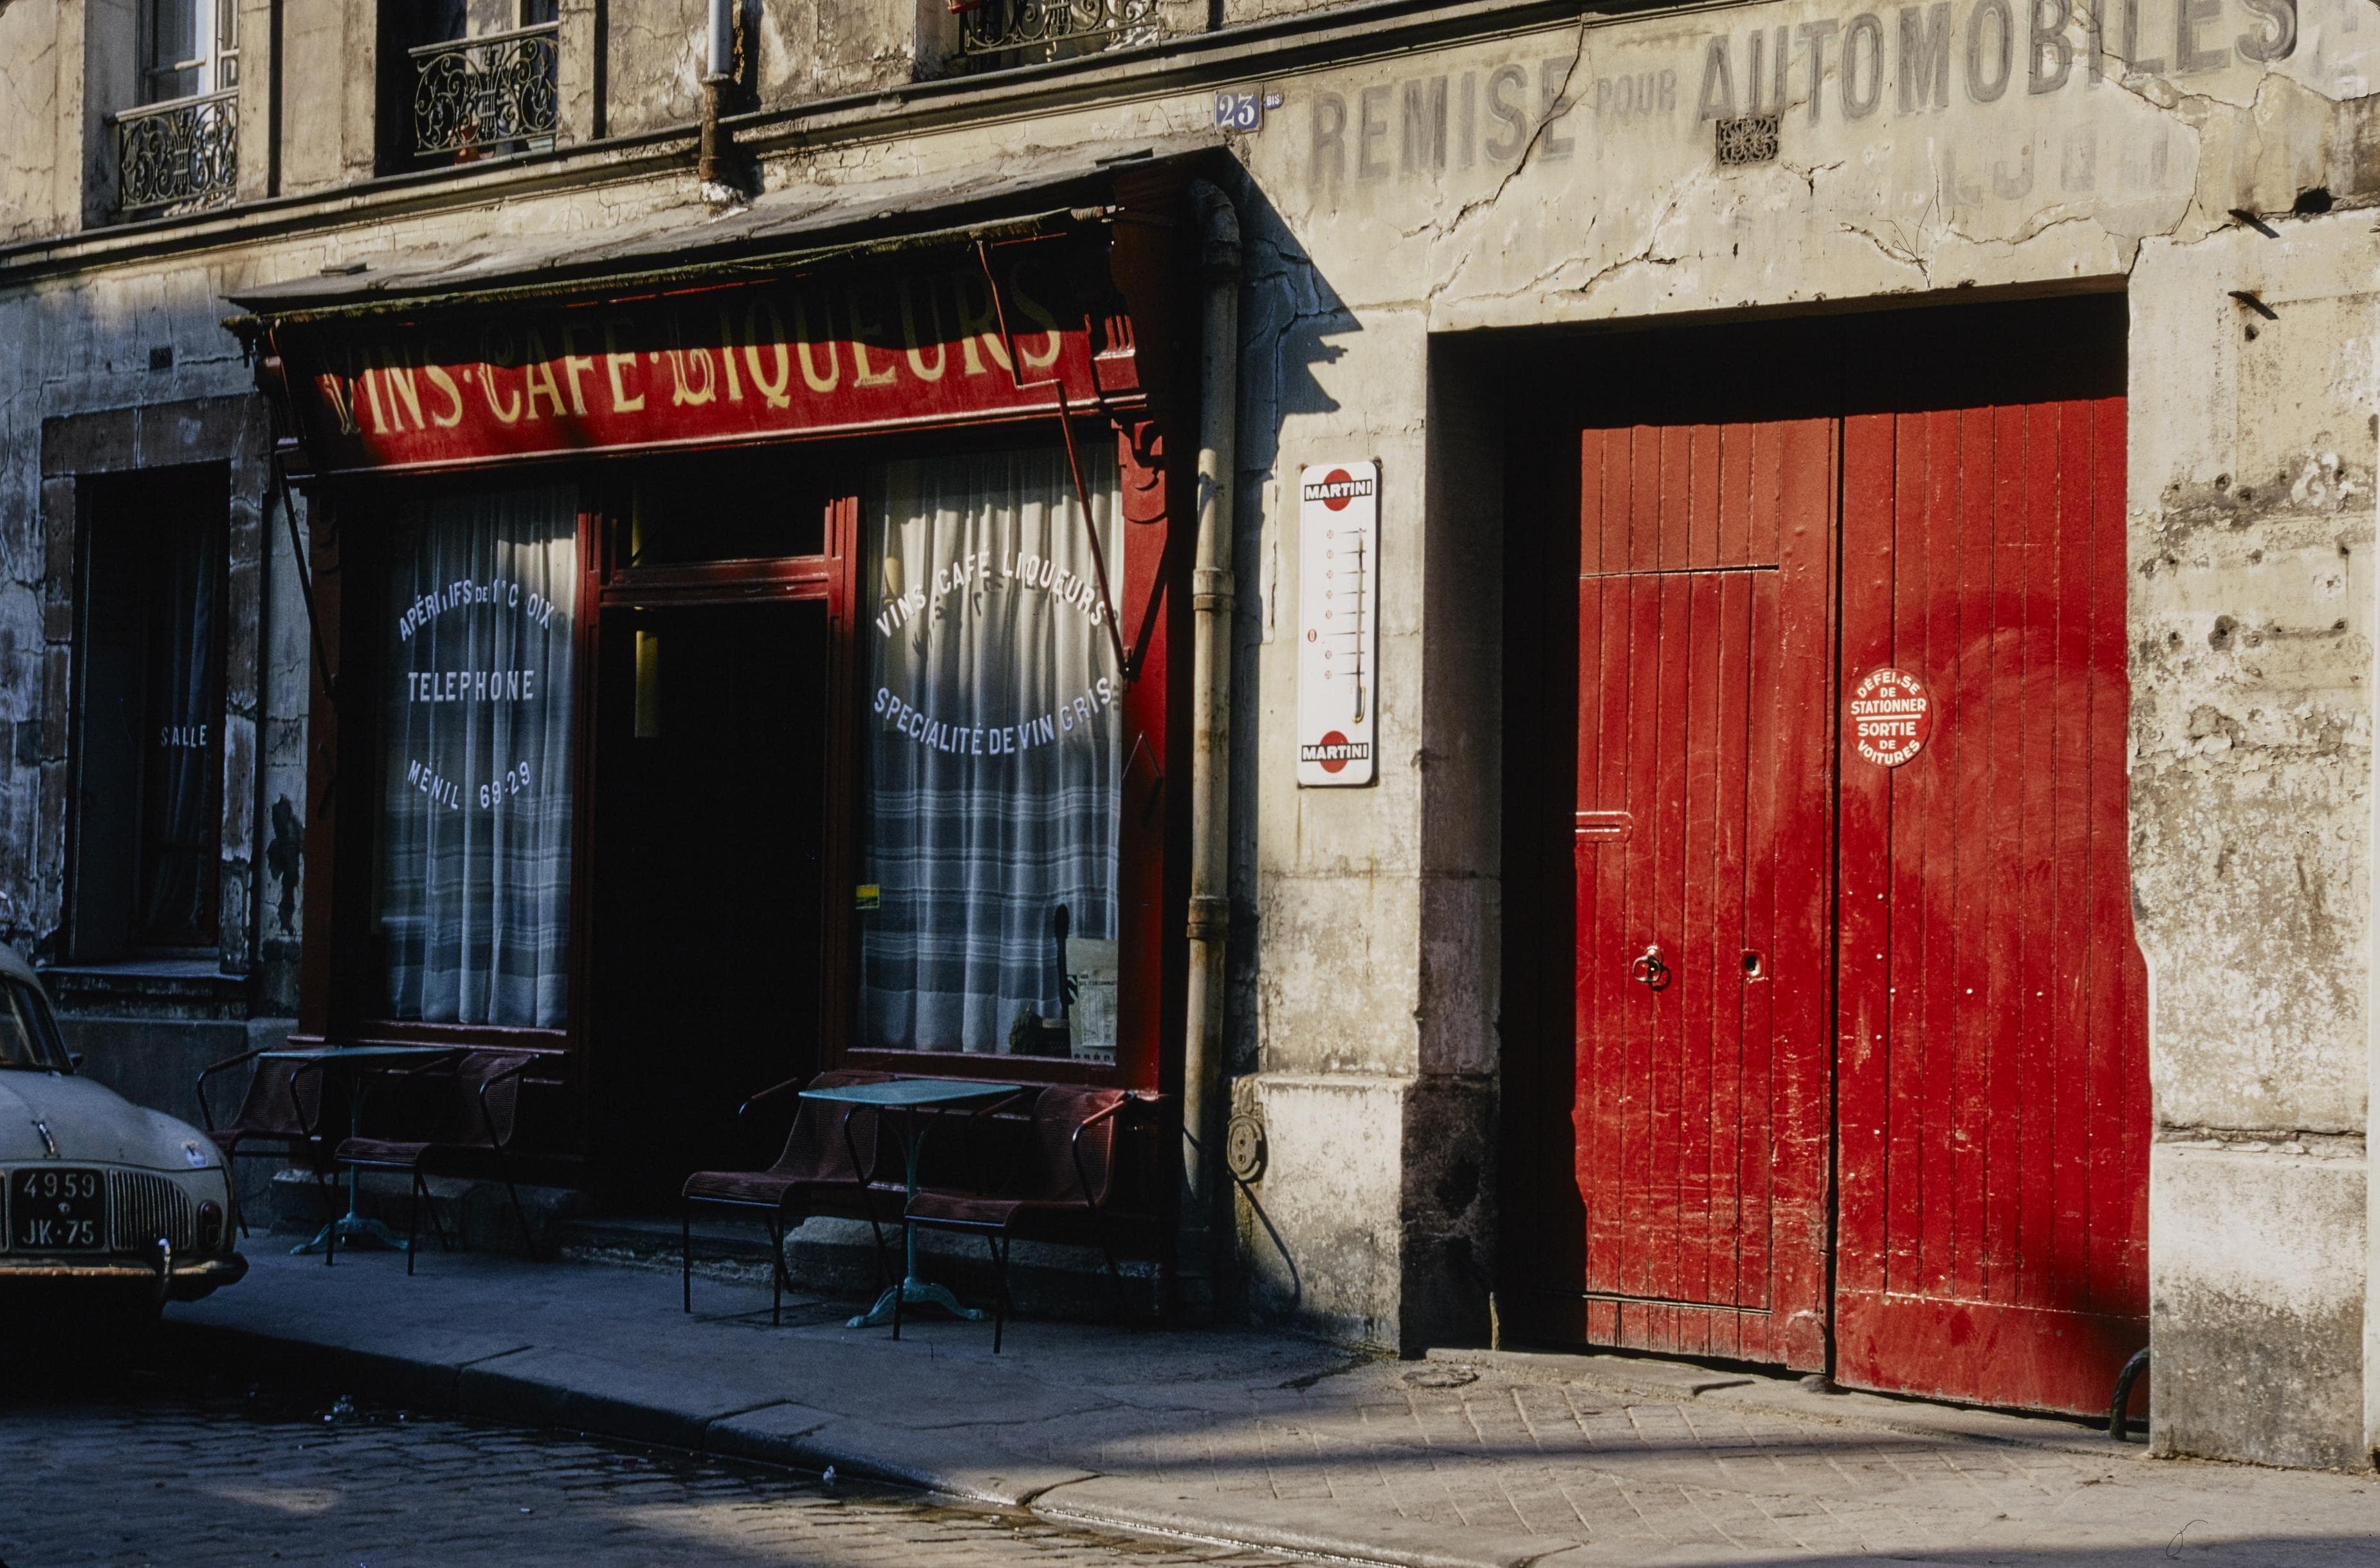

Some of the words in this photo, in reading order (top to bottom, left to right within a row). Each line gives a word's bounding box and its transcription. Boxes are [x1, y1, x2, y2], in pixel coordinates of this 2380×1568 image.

[1266, 94, 1280, 106] BIS
[1308, 55, 1578, 188] REMISE
[1596, 68, 1677, 118] POUR
[1697, 0, 2298, 124] AUTOMOBILES
[1219, 93, 1255, 127] 23
[315, 336, 464, 436] VINS
[1305, 480, 1372, 500] MARTINI
[475, 586, 488, 603] DE
[508, 583, 555, 629] COIX
[875, 584, 926, 638] VINS
[1002, 549, 1106, 626] LIQUEURS
[408, 670, 535, 702] TELEPHONE
[1880, 687, 1896, 697] DE
[874, 687, 984, 755] SPECIALITÉ
[989, 728, 1015, 755] DE
[1018, 714, 1055, 750] VIN
[1060, 678, 1112, 732] GRIS
[1851, 697, 1927, 715] STATIONNER
[161, 724, 207, 748] SALLE
[1858, 721, 1916, 737] SORTIE
[1302, 744, 1368, 761] MARTINI
[1858, 739, 1920, 765] VOITURES
[1879, 740, 1896, 750] DE
[23, 1173, 95, 1198] 4959
